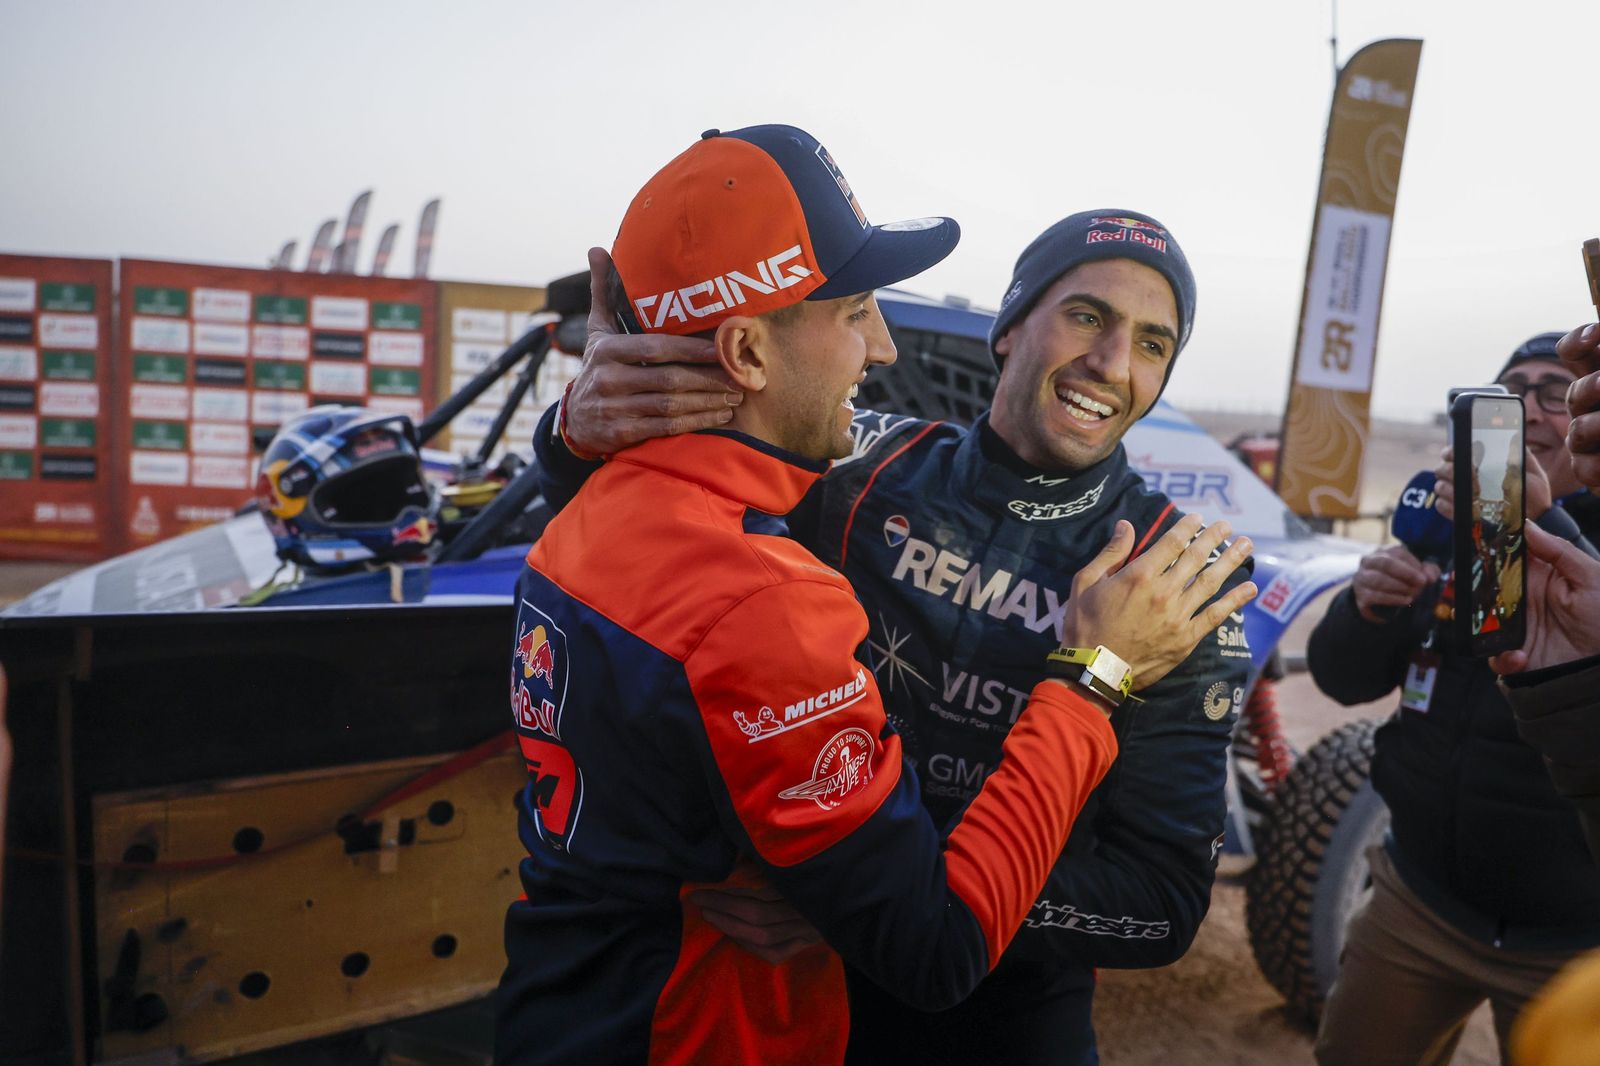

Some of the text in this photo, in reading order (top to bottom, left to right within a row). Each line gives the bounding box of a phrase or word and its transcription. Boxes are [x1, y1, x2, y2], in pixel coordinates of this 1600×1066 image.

[1086, 228, 1167, 254] Red Bull
[634, 244, 813, 330] RACING
[942, 661, 1030, 725] VIST
[820, 734, 868, 774] PROUD TO SUPPORT
[832, 752, 867, 788] WINGS
[840, 771, 859, 797] LIFE
[1025, 900, 1170, 939] lpinestars
